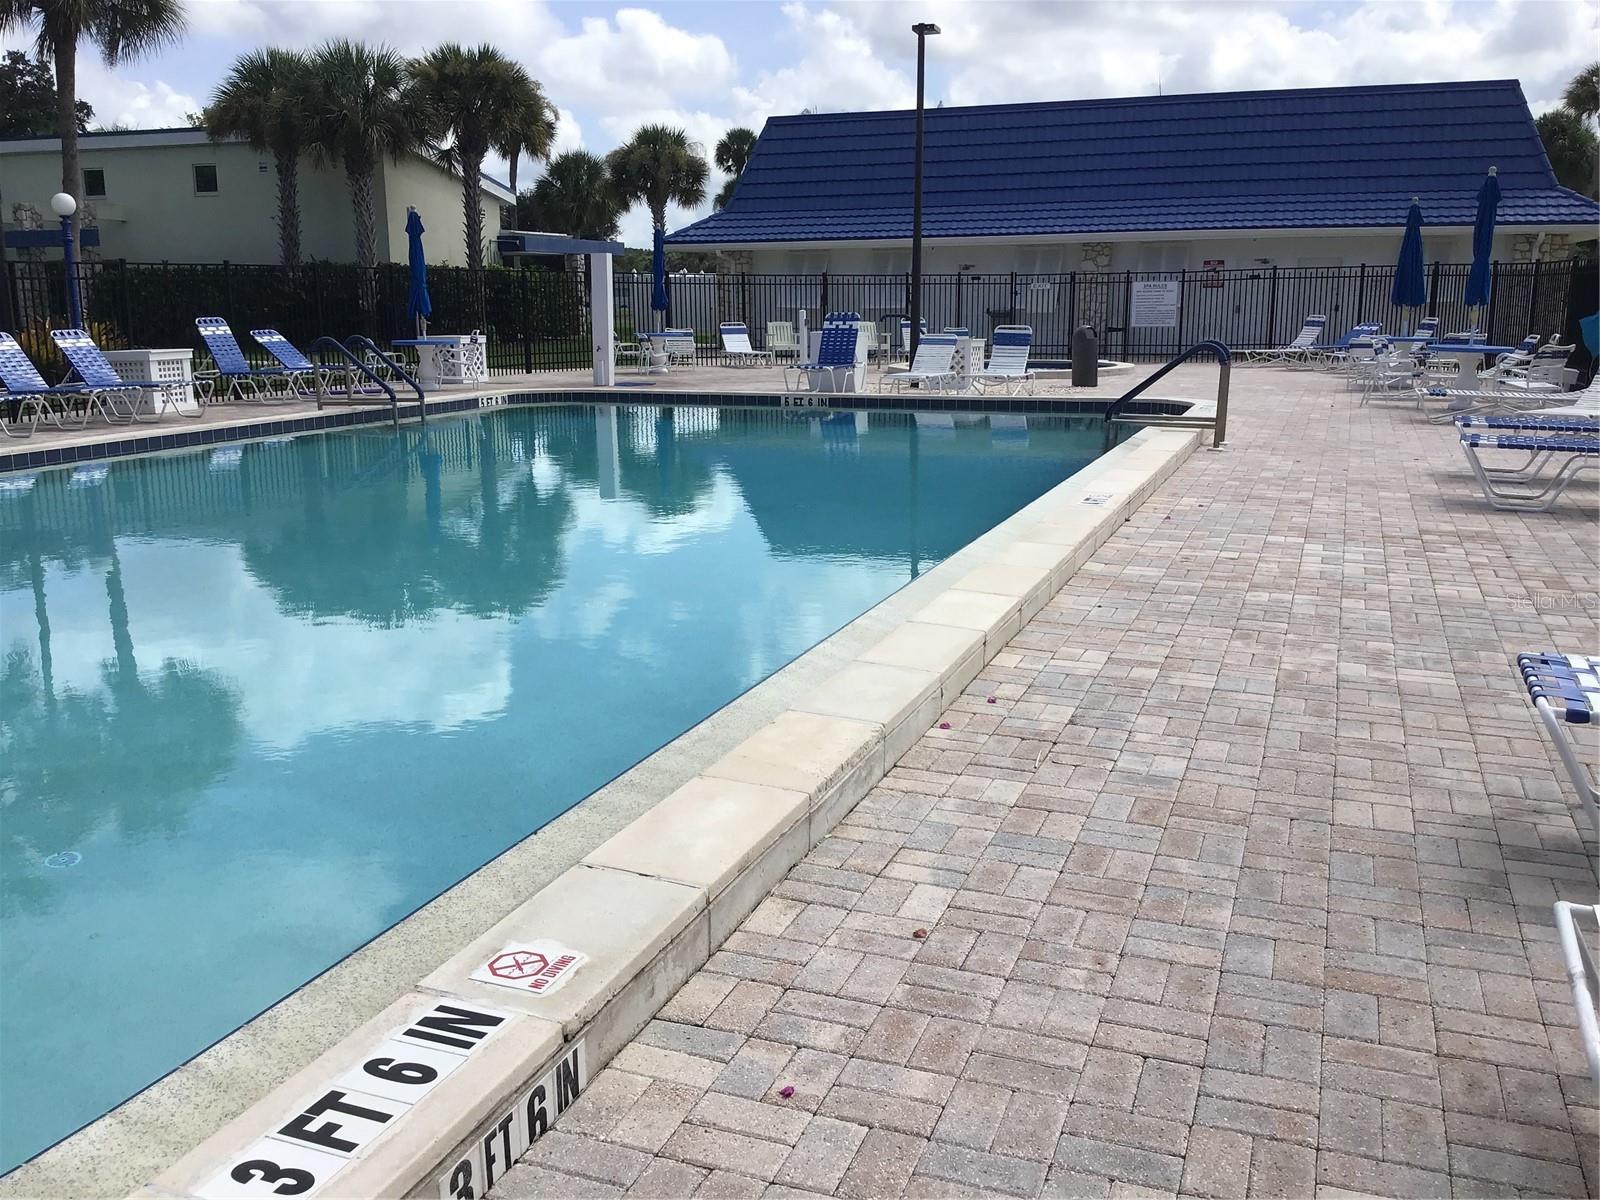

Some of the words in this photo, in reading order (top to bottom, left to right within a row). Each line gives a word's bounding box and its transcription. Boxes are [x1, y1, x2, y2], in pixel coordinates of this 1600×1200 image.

[784, 396, 790, 407] 5
[807, 397, 813, 407] 6
[817, 397, 828, 407] IN
[528, 978, 549, 989] NO
[541, 955, 577, 978] DIVING
[230, 1158, 315, 1196] 3
[277, 1089, 394, 1153] FT
[363, 1057, 438, 1085] 6
[401, 1004, 506, 1050] IN
[450, 1159, 475, 1200] 3
[484, 1111, 514, 1191] FT
[527, 1084, 548, 1146] 6
[555, 1047, 580, 1115] IN
